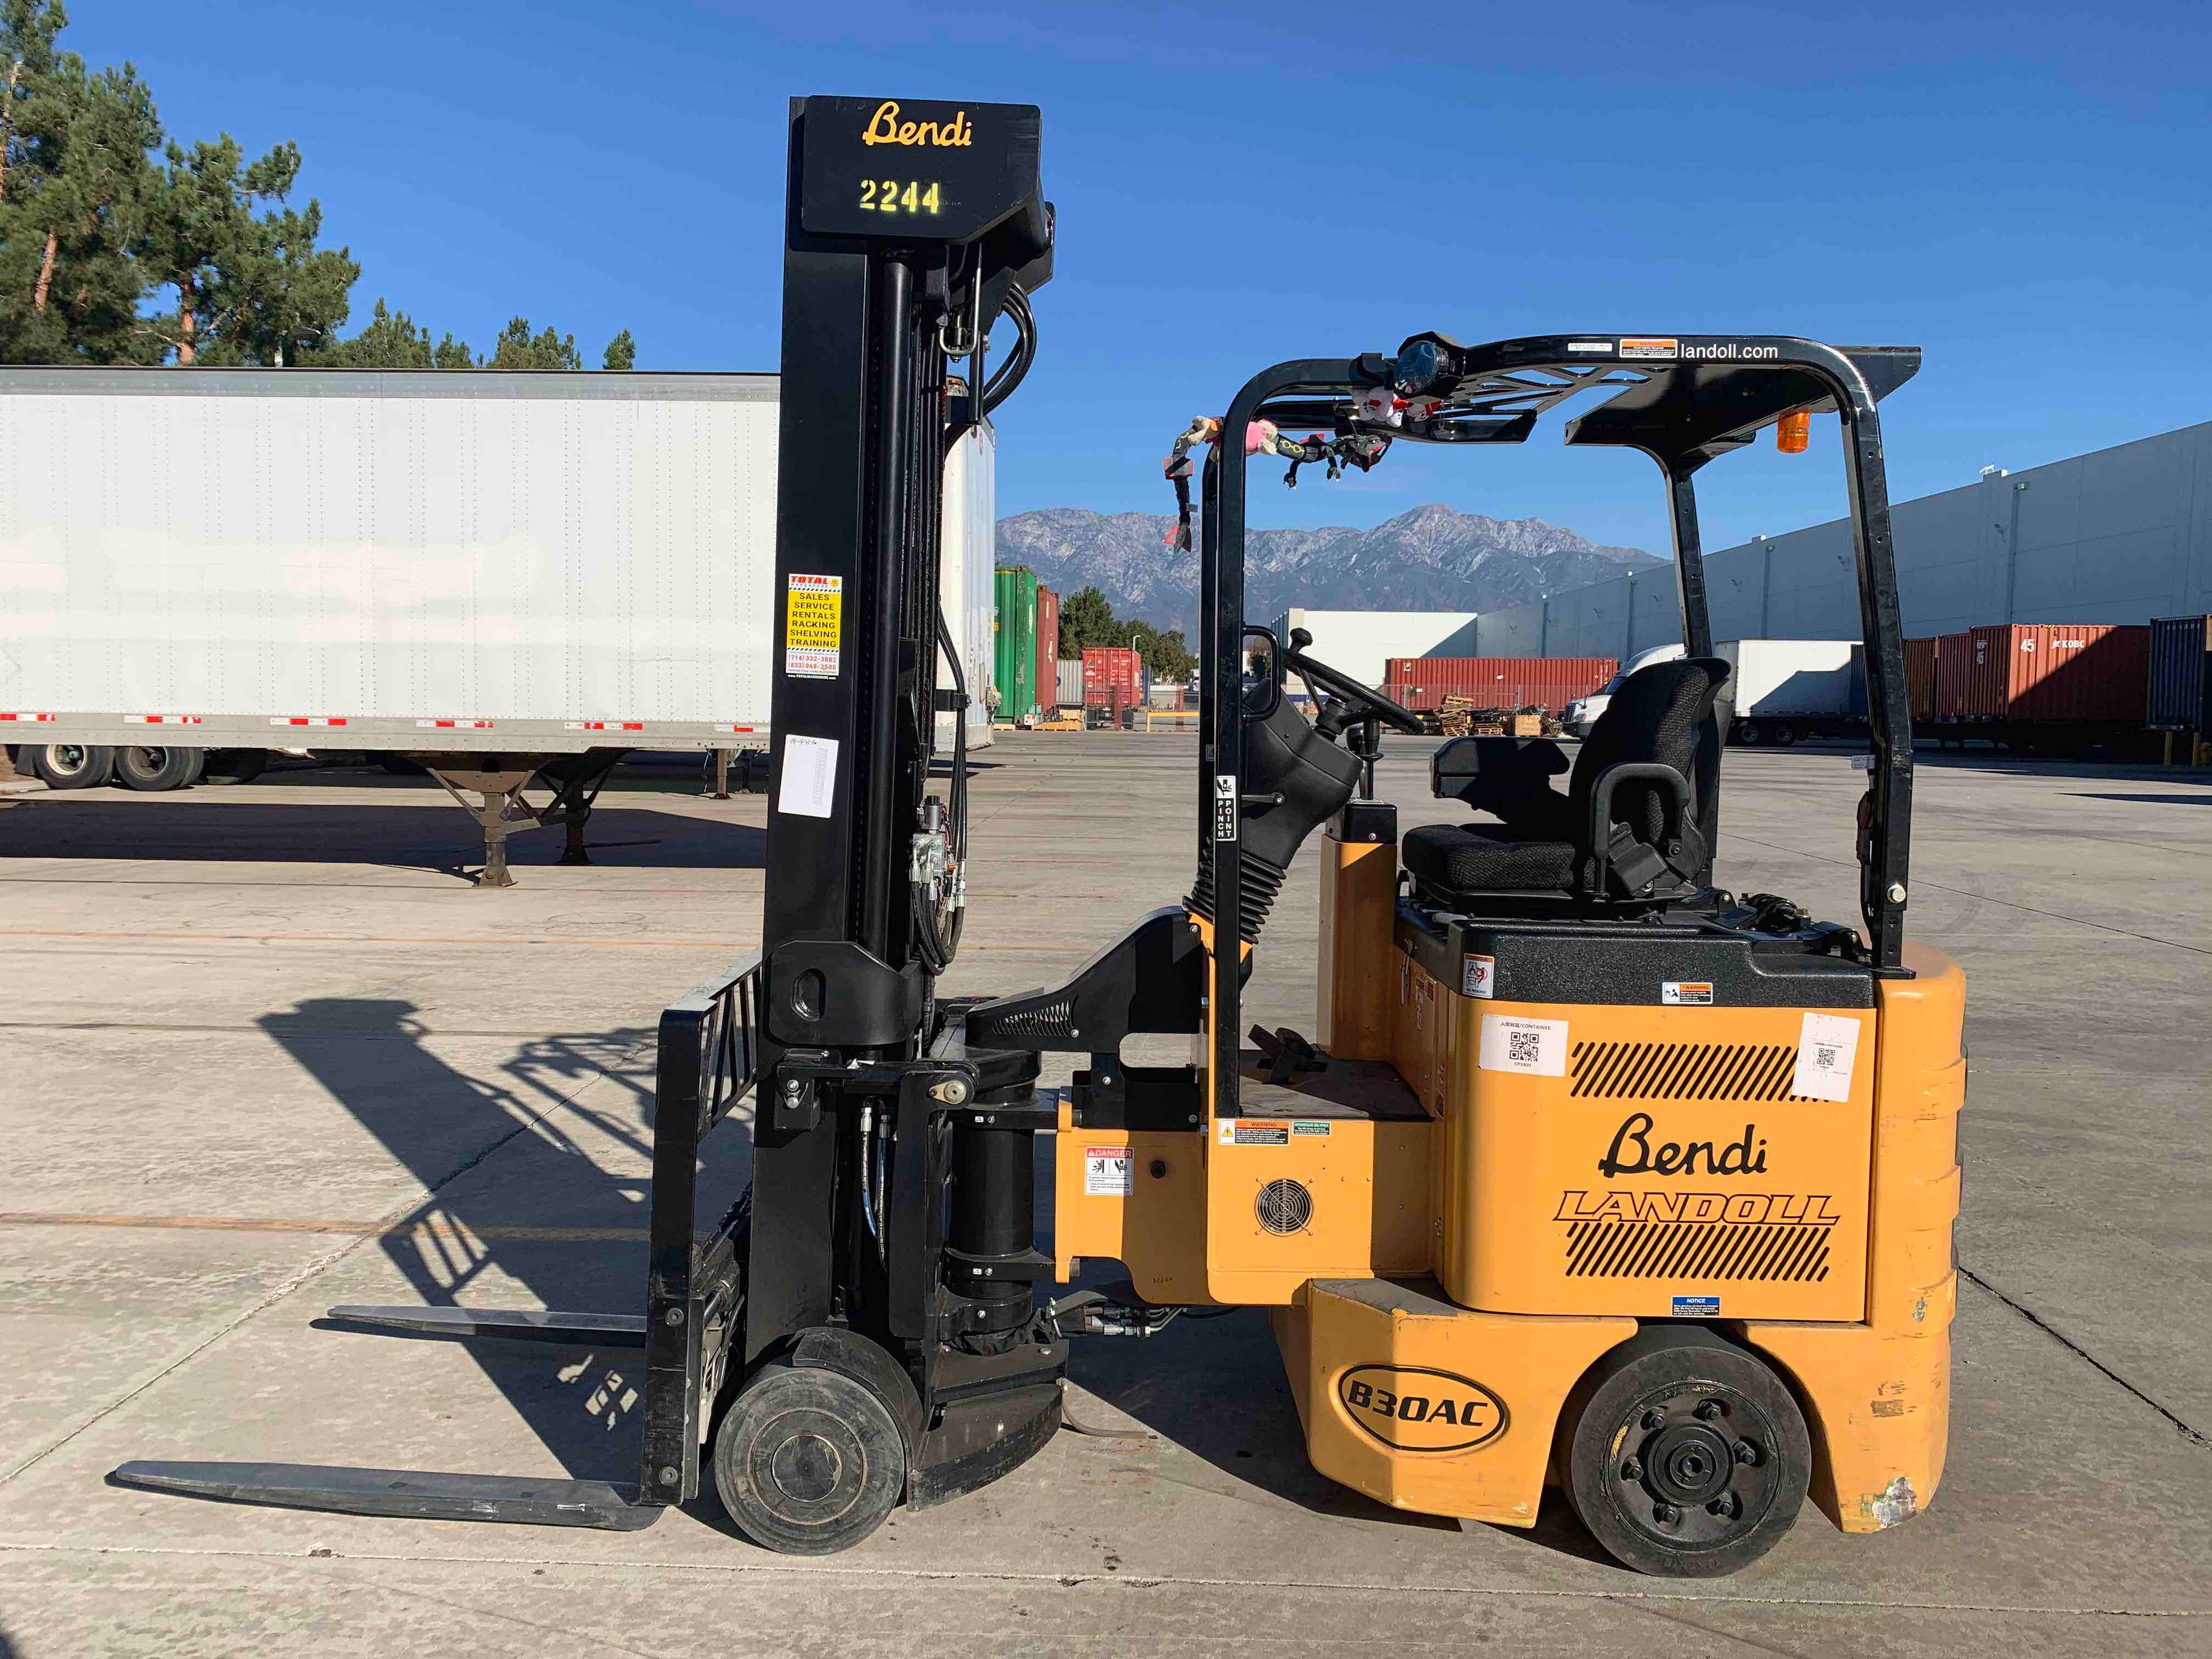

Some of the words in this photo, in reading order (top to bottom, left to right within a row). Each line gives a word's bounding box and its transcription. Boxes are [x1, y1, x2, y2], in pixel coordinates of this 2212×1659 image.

[862, 101, 972, 146] Bendi
[860, 180, 938, 214] 2244
[1681, 344, 1778, 359] landoll.com
[791, 576, 828, 584] TOTAL
[794, 602, 834, 610] SERVICE
[792, 611, 835, 619] RENTALS
[792, 620, 835, 628] RACKING
[790, 630, 836, 638] SHELVING
[790, 639, 836, 647] TRAINING
[2020, 639, 2035, 652] 45
[2062, 639, 2085, 648] KOBC
[1598, 1112, 1768, 1178] Bendi
[1096, 1149, 1131, 1157] DANGER
[1552, 1190, 1842, 1226] LANDOLL
[1347, 1380, 1488, 1427] B30AC
